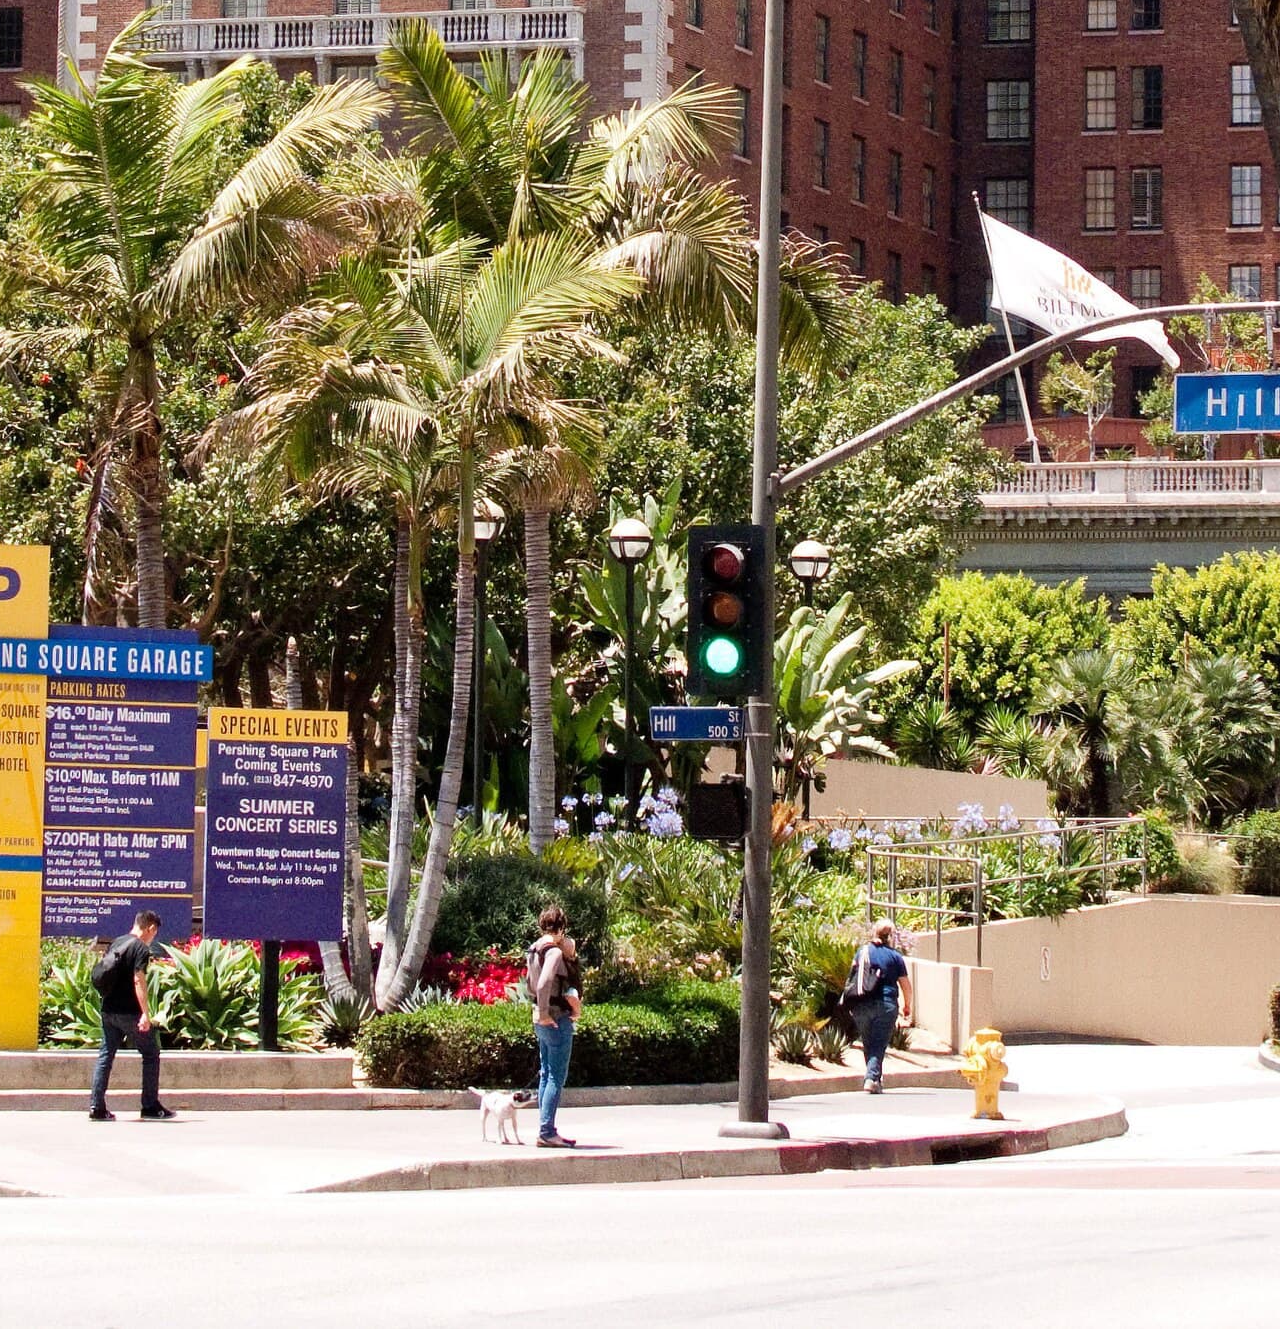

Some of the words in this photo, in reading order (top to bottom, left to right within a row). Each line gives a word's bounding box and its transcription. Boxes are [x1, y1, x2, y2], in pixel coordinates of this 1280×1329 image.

[1207, 387, 1280, 416] Hill
[38, 644, 118, 674] SQUARE
[128, 648, 204, 676] GARAGE
[27, 683, 40, 693] FOR
[50, 682, 93, 697] PARKING
[96, 683, 126, 698] RATES
[1, 704, 40, 719] SQUARE
[87, 706, 114, 723] Daily
[117, 707, 171, 723] Maximum
[220, 715, 279, 736] SPECIAL
[286, 717, 338, 738] EVENTS
[654, 715, 676, 732] Hill
[728, 711, 740, 723] St
[708, 725, 728, 737] 500
[732, 726, 739, 737] S
[66, 742, 86, 750] Ticket
[218, 743, 266, 758] Pershing
[270, 745, 309, 758] Square
[313, 746, 338, 758] Park
[49, 751, 83, 760] Overnight
[84, 752, 110, 761] Parking
[0, 757, 29, 772] HOTEL
[235, 758, 277, 772] Coming
[282, 759, 321, 772] Events
[81, 769, 108, 784] Max.
[112, 770, 147, 785] Before
[150, 772, 180, 786] 11AM
[222, 772, 249, 786] Info.
[273, 774, 333, 788] 847-4970
[49, 785, 66, 794] Early
[83, 786, 108, 795] Parking
[66, 795, 95, 804] Entering
[96, 796, 119, 804] Before
[239, 798, 315, 815] SUMMER
[215, 817, 283, 833] CONCERT
[288, 819, 338, 835] SERIES
[4, 837, 35, 846] PARKING
[79, 832, 100, 847] Flat
[103, 833, 128, 847] Rate
[131, 834, 158, 848] After
[161, 835, 187, 849] 5PM
[211, 846, 254, 857] Downtown
[255, 847, 279, 859] Stage
[281, 848, 314, 859] Concert
[315, 848, 340, 859] Series
[112, 870, 142, 878] Holidays
[280, 862, 293, 873] July
[304, 863, 312, 871] to
[313, 863, 327, 873] Aug
[46, 878, 106, 888] CASH-CREDIT
[107, 879, 138, 888] CARDS
[140, 880, 187, 889] ACCEPTED
[227, 875, 261, 884] Concerts
[262, 875, 283, 886] Begin
[284, 876, 293, 884] at
[294, 876, 324, 887] 8:00pm
[45, 896, 73, 905] Monthly
[73, 897, 100, 906] Parking
[100, 898, 131, 906] Available
[58, 906, 97, 914] Information
